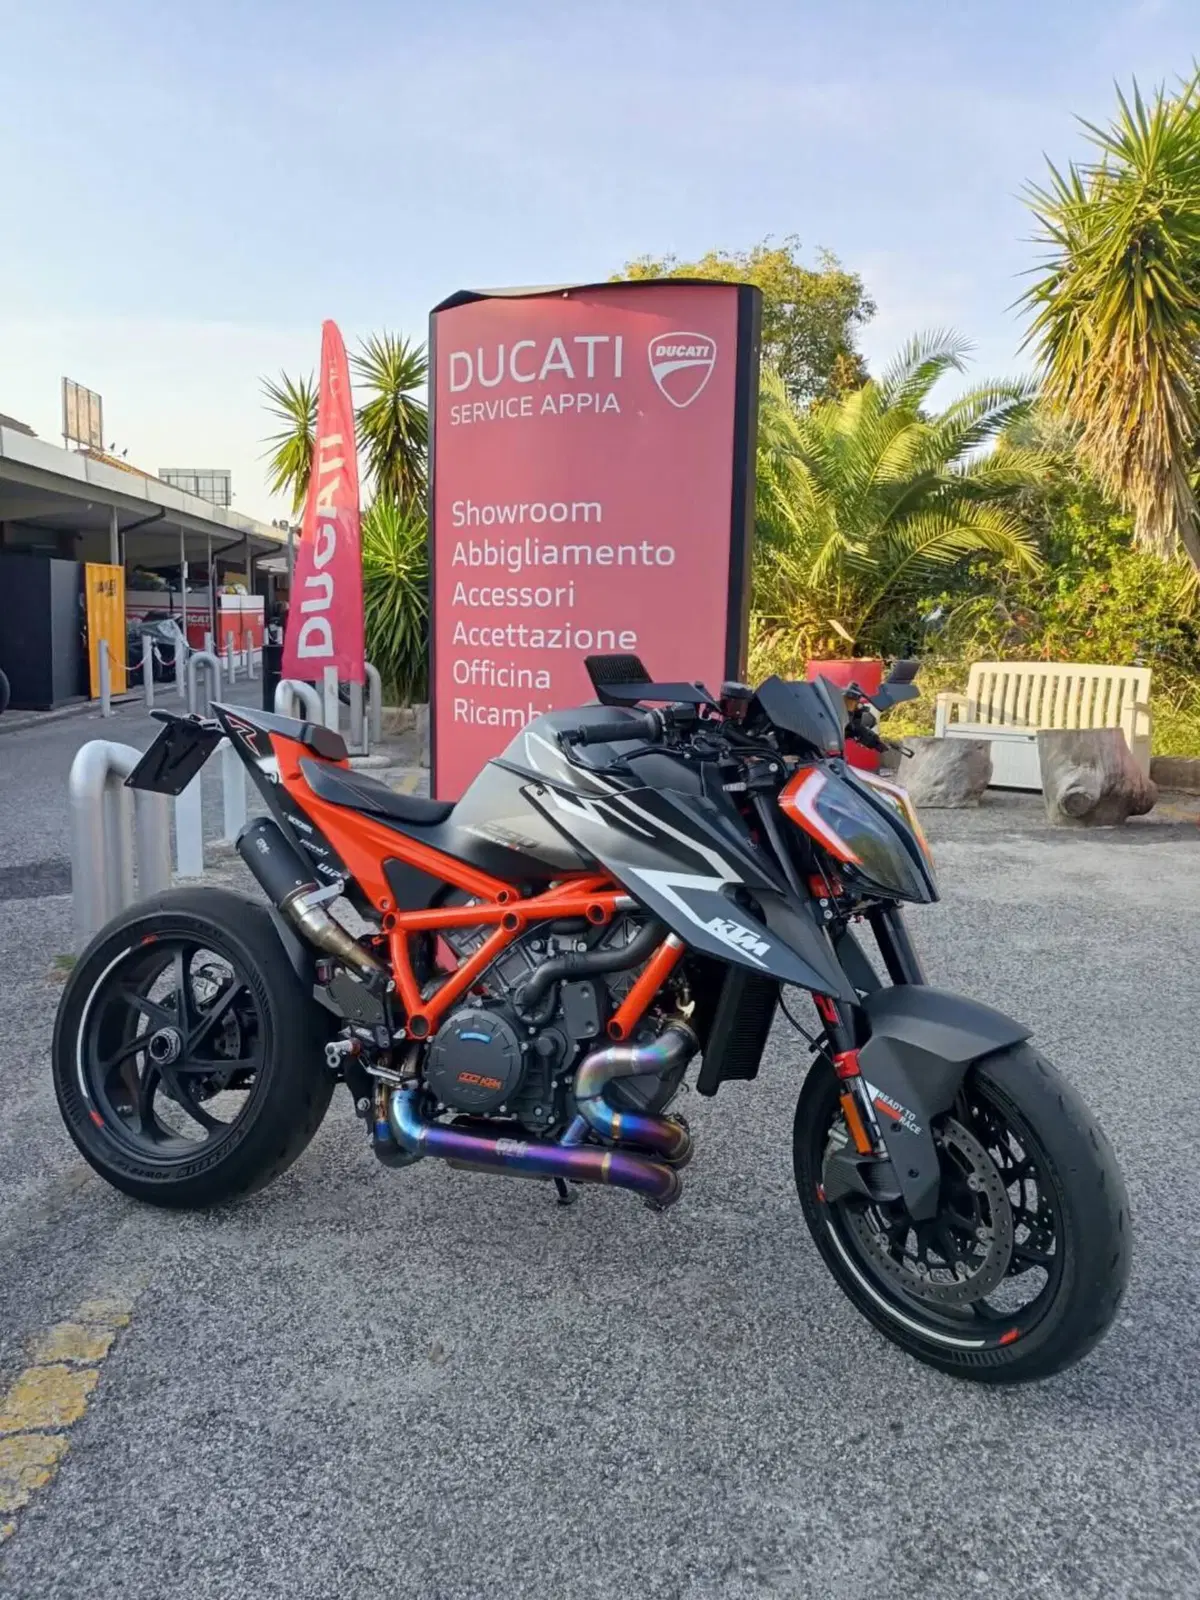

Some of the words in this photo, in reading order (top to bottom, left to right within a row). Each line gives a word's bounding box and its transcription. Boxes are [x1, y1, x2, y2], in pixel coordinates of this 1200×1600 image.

[450, 335, 623, 393] DUCATI
[655, 344, 710, 358] DUCATI
[450, 395, 533, 426] SERVICE
[540, 392, 621, 415] APPIA
[451, 499, 602, 527] Showroom
[297, 432, 343, 658] DUCATI
[451, 537, 676, 573] Abbigliamento
[452, 580, 575, 608] Accessori
[452, 620, 638, 651] Accettazione
[452, 659, 551, 690] Officina
[453, 697, 552, 728] Ricamb
[707, 916, 772, 957] KTM
[876, 1090, 904, 1113] READY
[904, 1109, 917, 1121] TO
[898, 1115, 922, 1135] RACE
